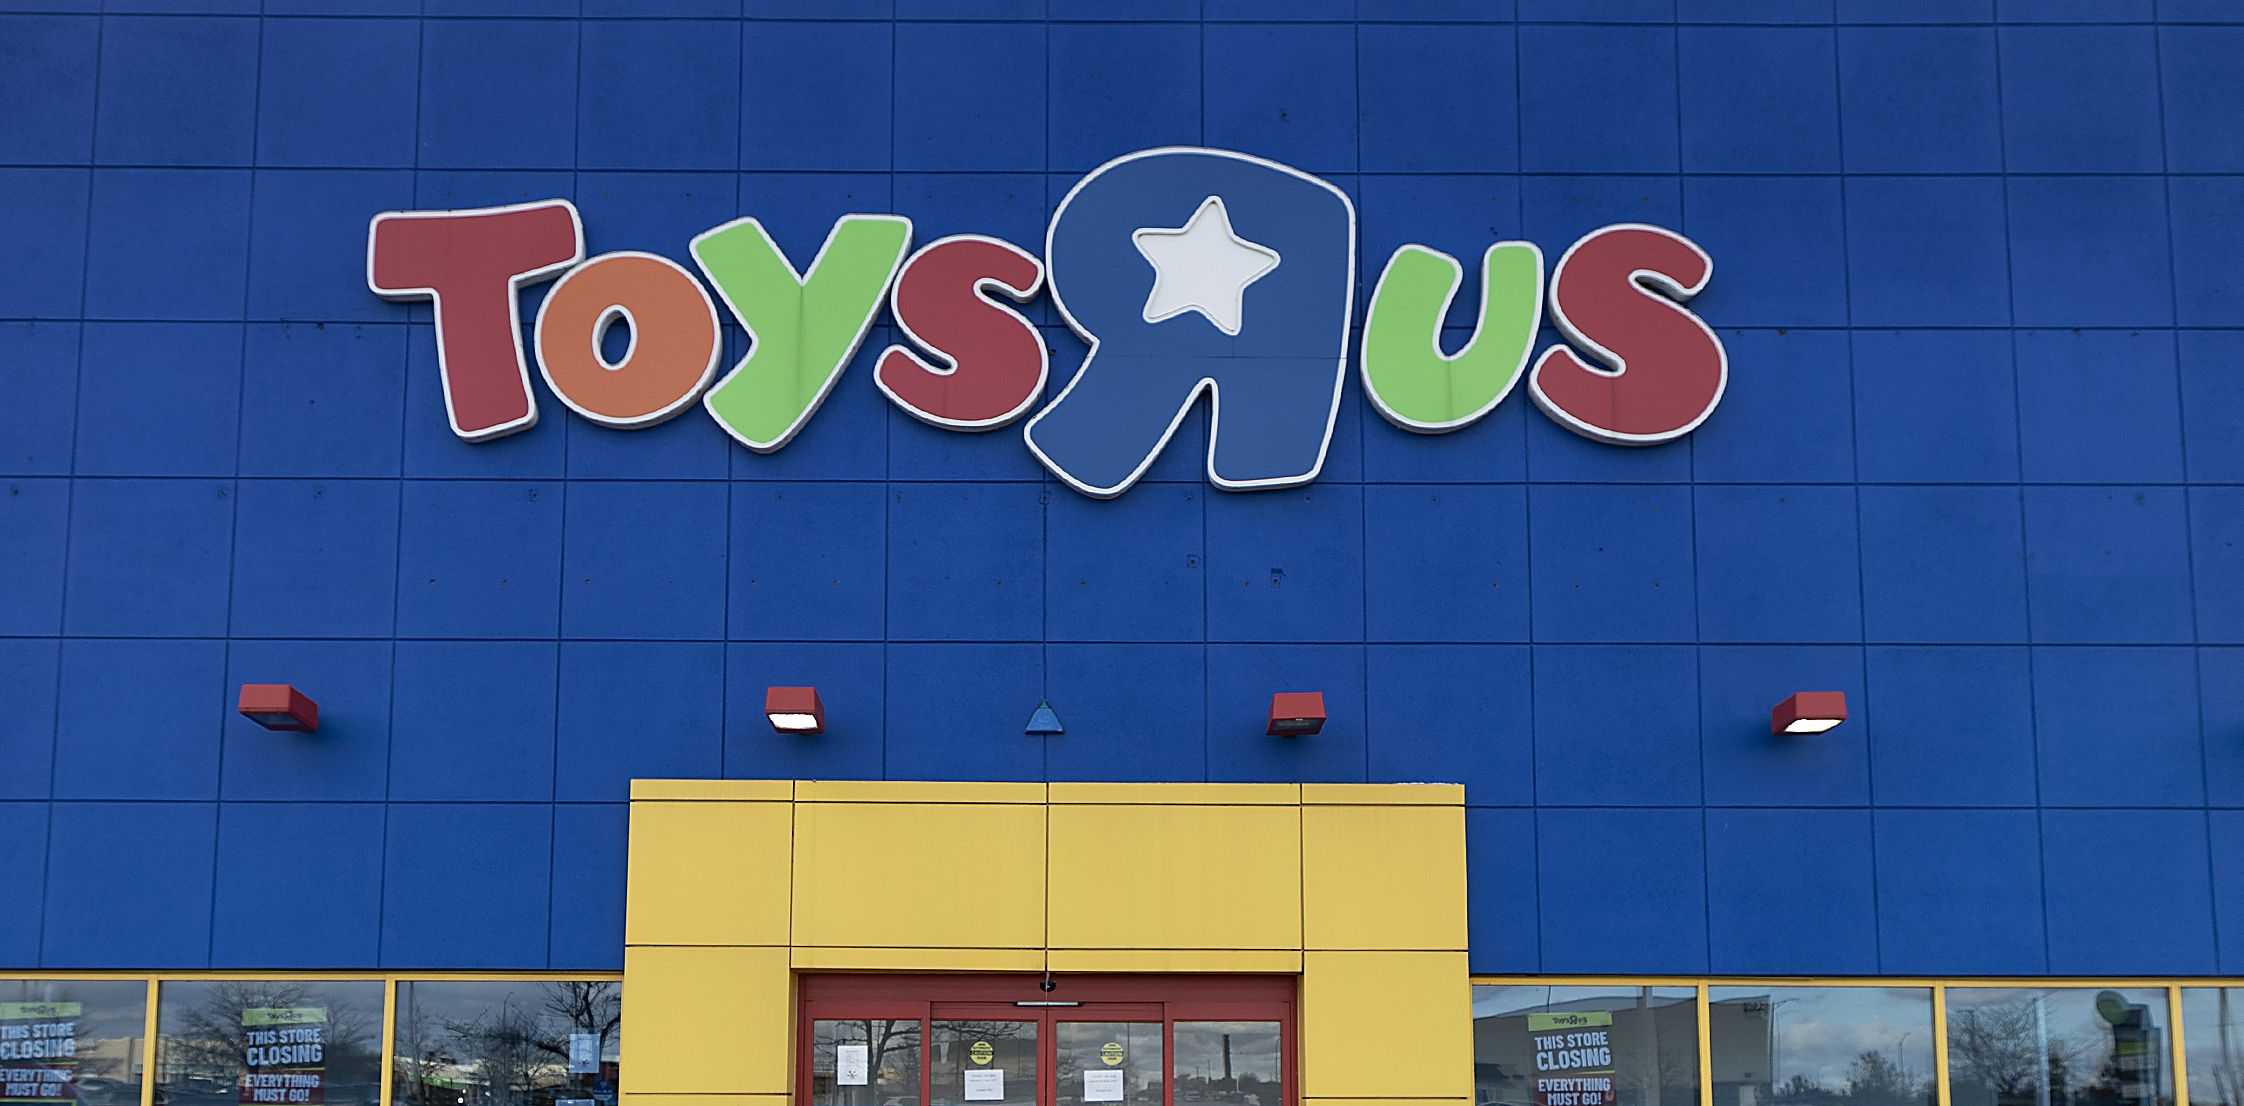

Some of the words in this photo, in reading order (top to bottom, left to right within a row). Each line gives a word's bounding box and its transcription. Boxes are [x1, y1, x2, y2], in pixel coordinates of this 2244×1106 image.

[1, 1025, 30, 1039] THIS
[32, 1022, 74, 1038] STORE
[246, 1030, 276, 1045] THIS
[279, 1028, 321, 1043] STORE
[0, 1038, 76, 1059] CLOSING
[1534, 1034, 1564, 1050] THIS
[1567, 1031, 1608, 1047] STORE
[246, 1043, 322, 1066] CLOSING
[1536, 1046, 1611, 1071] CLOSING
[0, 1069, 72, 1083] EVERYTHING
[245, 1073, 320, 1088] EVERYTHING
[5, 1082, 39, 1097] MUST
[40, 1082, 63, 1096] GO!
[1538, 1077, 1611, 1092] EVERYTHING
[253, 1088, 286, 1102] MUST
[288, 1088, 310, 1102] GO!
[1547, 1092, 1579, 1106] MUST
[1582, 1092, 1602, 1105] GO!
